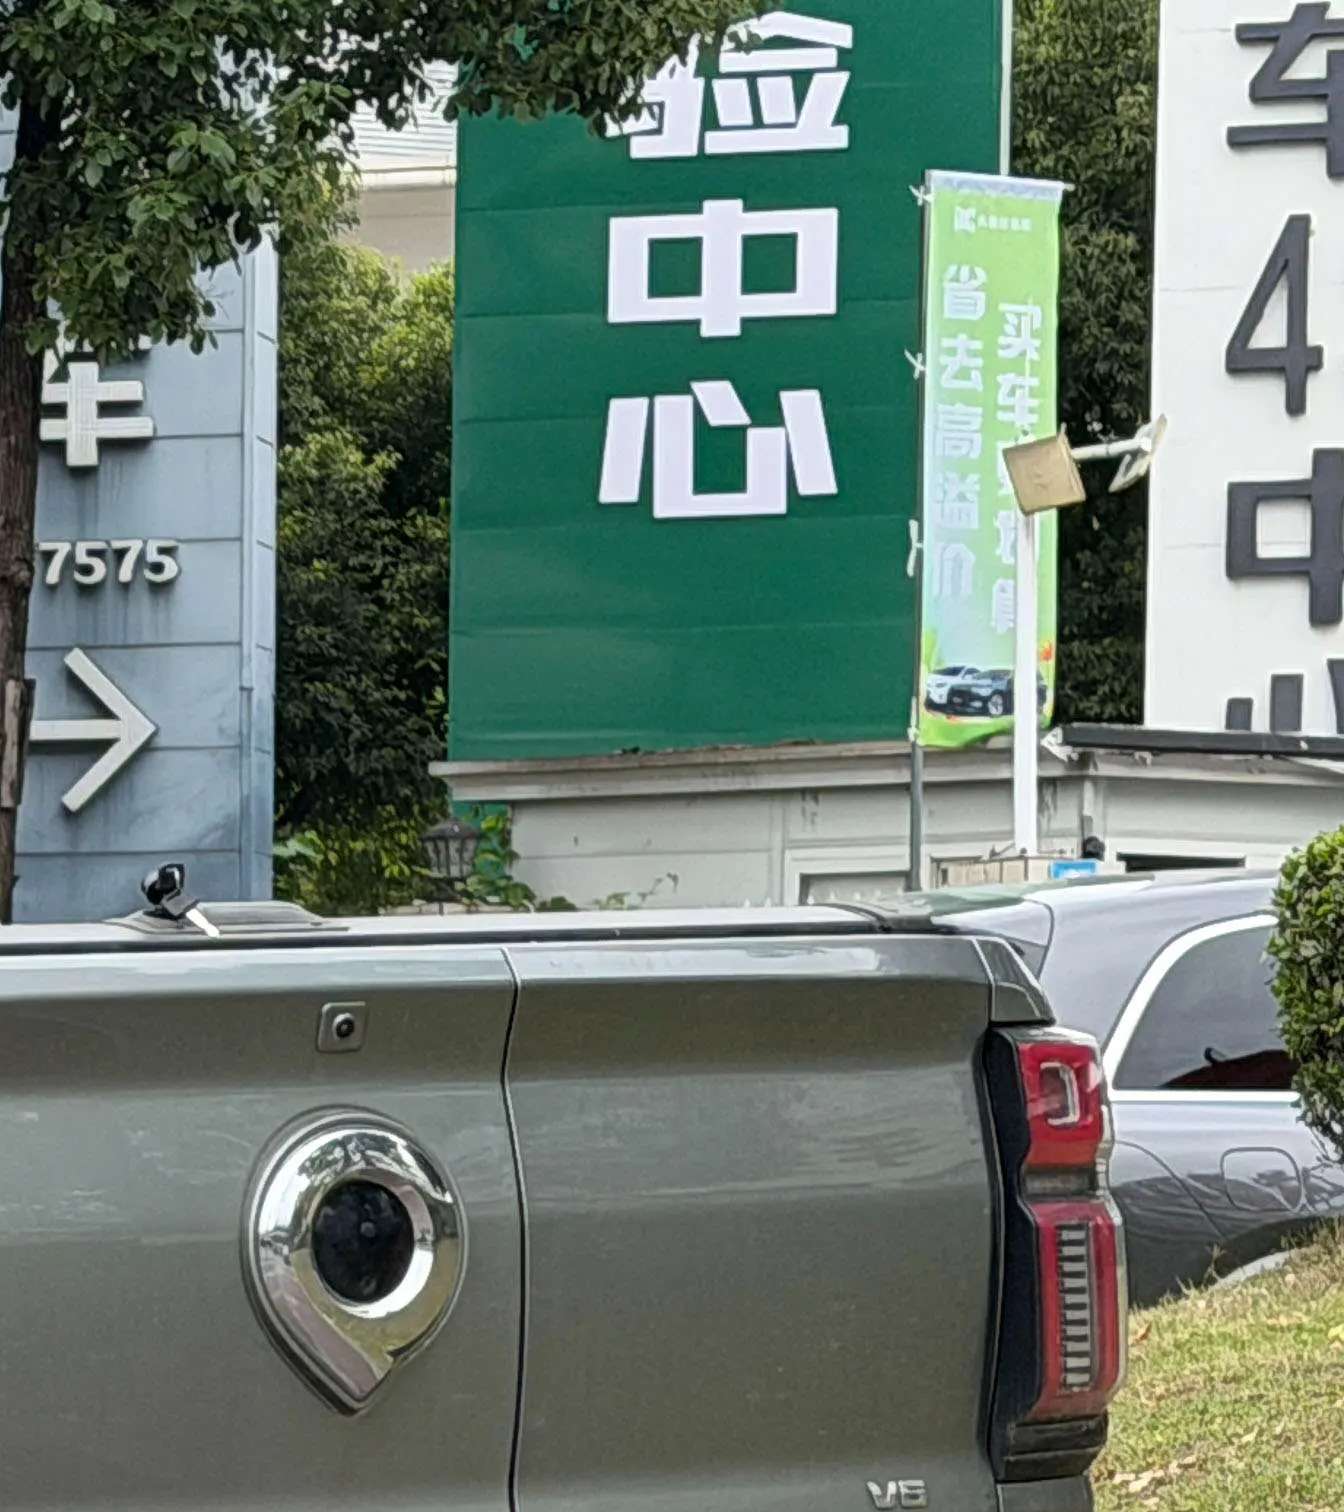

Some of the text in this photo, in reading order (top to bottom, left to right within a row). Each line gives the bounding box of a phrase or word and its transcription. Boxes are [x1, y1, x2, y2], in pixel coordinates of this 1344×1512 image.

[599, 11, 854, 519] 验中心
[39, 540, 179, 585] 7575
[866, 1479, 928, 1509] V6
